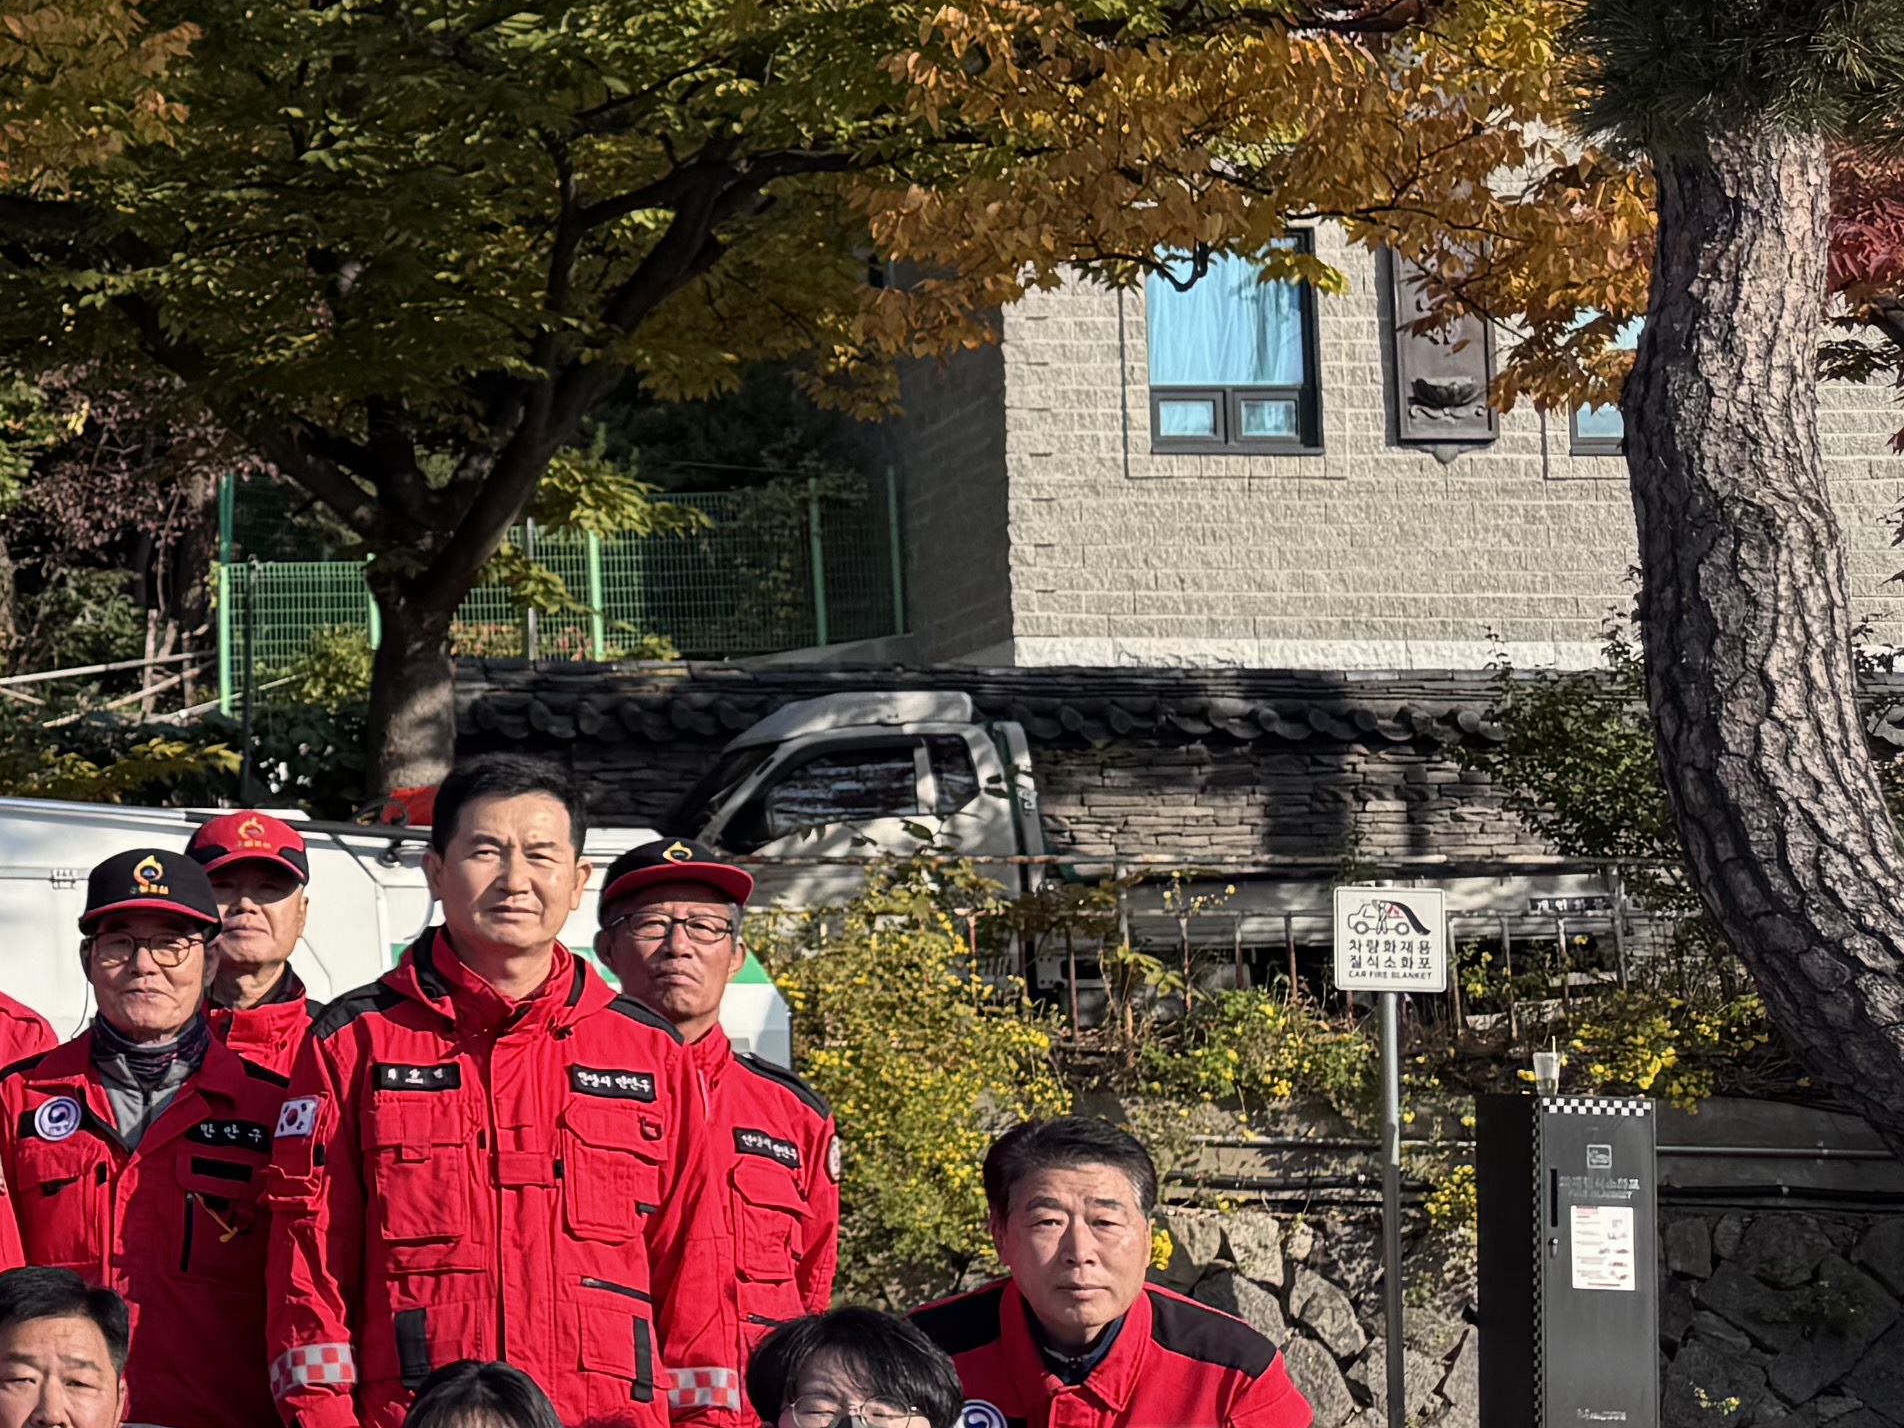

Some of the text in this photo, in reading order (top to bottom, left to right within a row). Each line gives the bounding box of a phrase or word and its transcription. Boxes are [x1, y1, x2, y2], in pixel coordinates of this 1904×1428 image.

[1348, 938, 1433, 955] 차량화재용
[1349, 954, 1433, 971] 질식소화포
[1348, 970, 1433, 981] CAR FIRE BLANKET
[199, 1122, 263, 1144] 만안구
